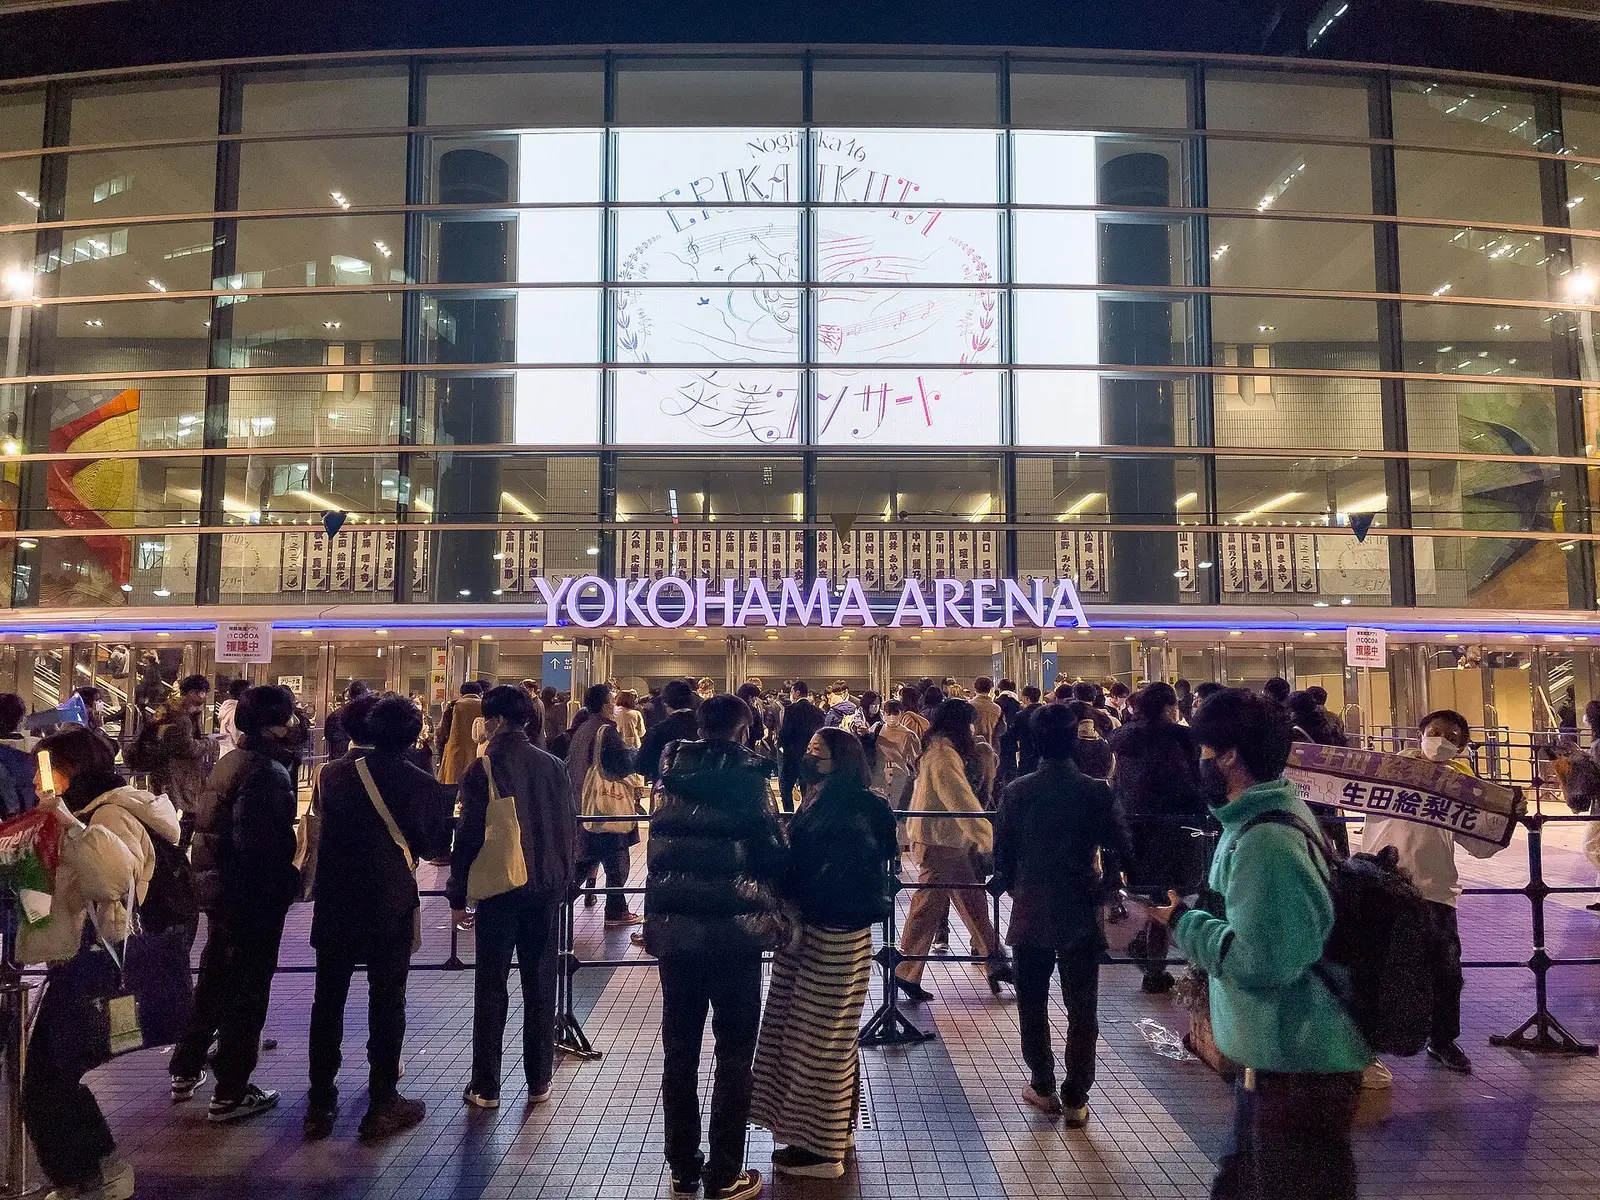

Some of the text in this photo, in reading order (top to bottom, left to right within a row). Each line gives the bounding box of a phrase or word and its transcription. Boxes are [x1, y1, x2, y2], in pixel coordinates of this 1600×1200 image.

[746, 131, 866, 162] Nogika46
[505, 531, 515, 553] 金川
[529, 531, 538, 553] 北川
[865, 532, 875, 554] 田村
[912, 532, 921, 553] 中村
[935, 532, 945, 554] 早川
[889, 554, 898, 582] あやめ
[533, 577, 1090, 628] YOKOHAMA ARENA
[226, 641, 259, 652] 確認中
[1340, 783, 1480, 831] 生田絵梨花
